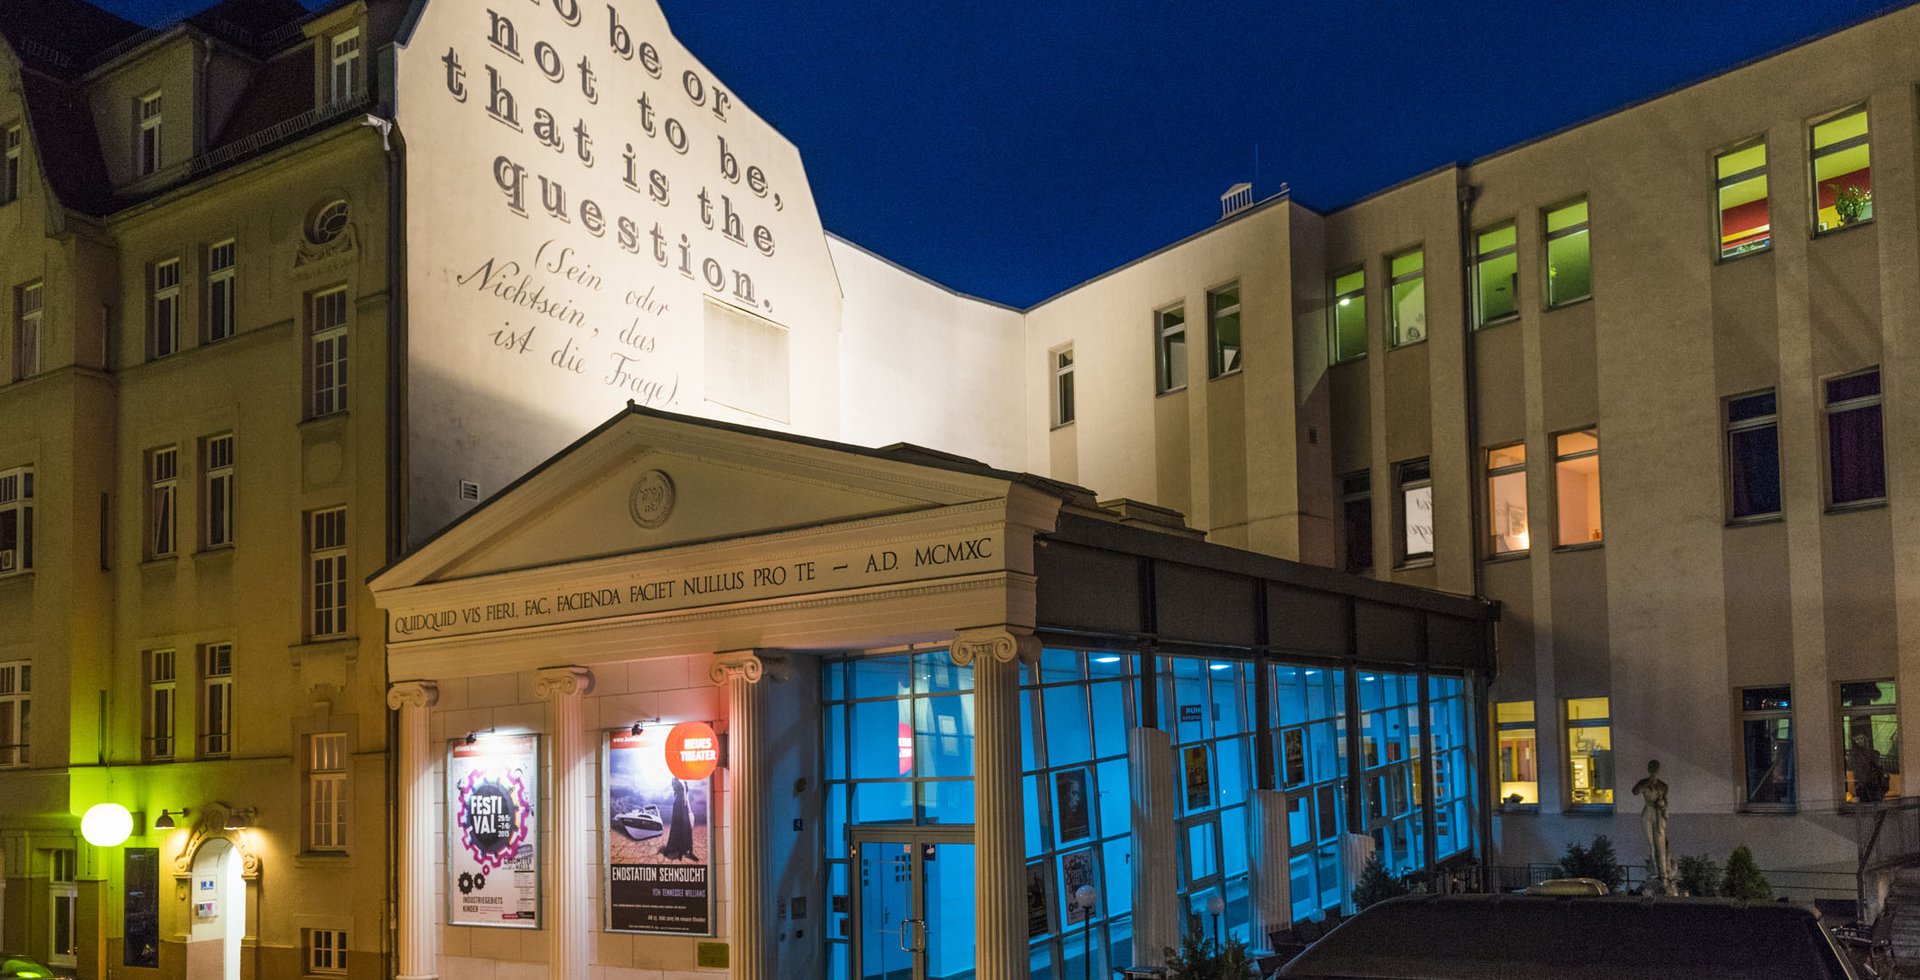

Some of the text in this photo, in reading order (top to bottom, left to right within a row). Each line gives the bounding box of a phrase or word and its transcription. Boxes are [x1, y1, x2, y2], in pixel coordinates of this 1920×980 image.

[607, 4, 662, 79] be
[682, 69, 731, 121] or
[487, 8, 783, 211] not to be,
[441, 47, 775, 257] that is the
[493, 155, 773, 313] question.
[534, 239, 671, 317] (Sein oder
[488, 321, 680, 407] ist die Frage).
[619, 317, 656, 353] das
[394, 609, 457, 635] QUIDQUID
[462, 606, 481, 625] VIS
[556, 588, 622, 612] FACIENDA
[629, 580, 677, 602] FACIET
[683, 571, 745, 596] NULLUS
[753, 566, 787, 587] PRO
[794, 561, 816, 581] TE
[865, 551, 899, 573] A.D.
[914, 537, 993, 567] MCMXC
[680, 750, 716, 762] THEATER
[684, 738, 711, 749] NEUES
[470, 795, 502, 815] FESTI
[473, 814, 497, 834] VAL
[612, 867, 706, 883] ENDSTATION SEHNSUCHT
